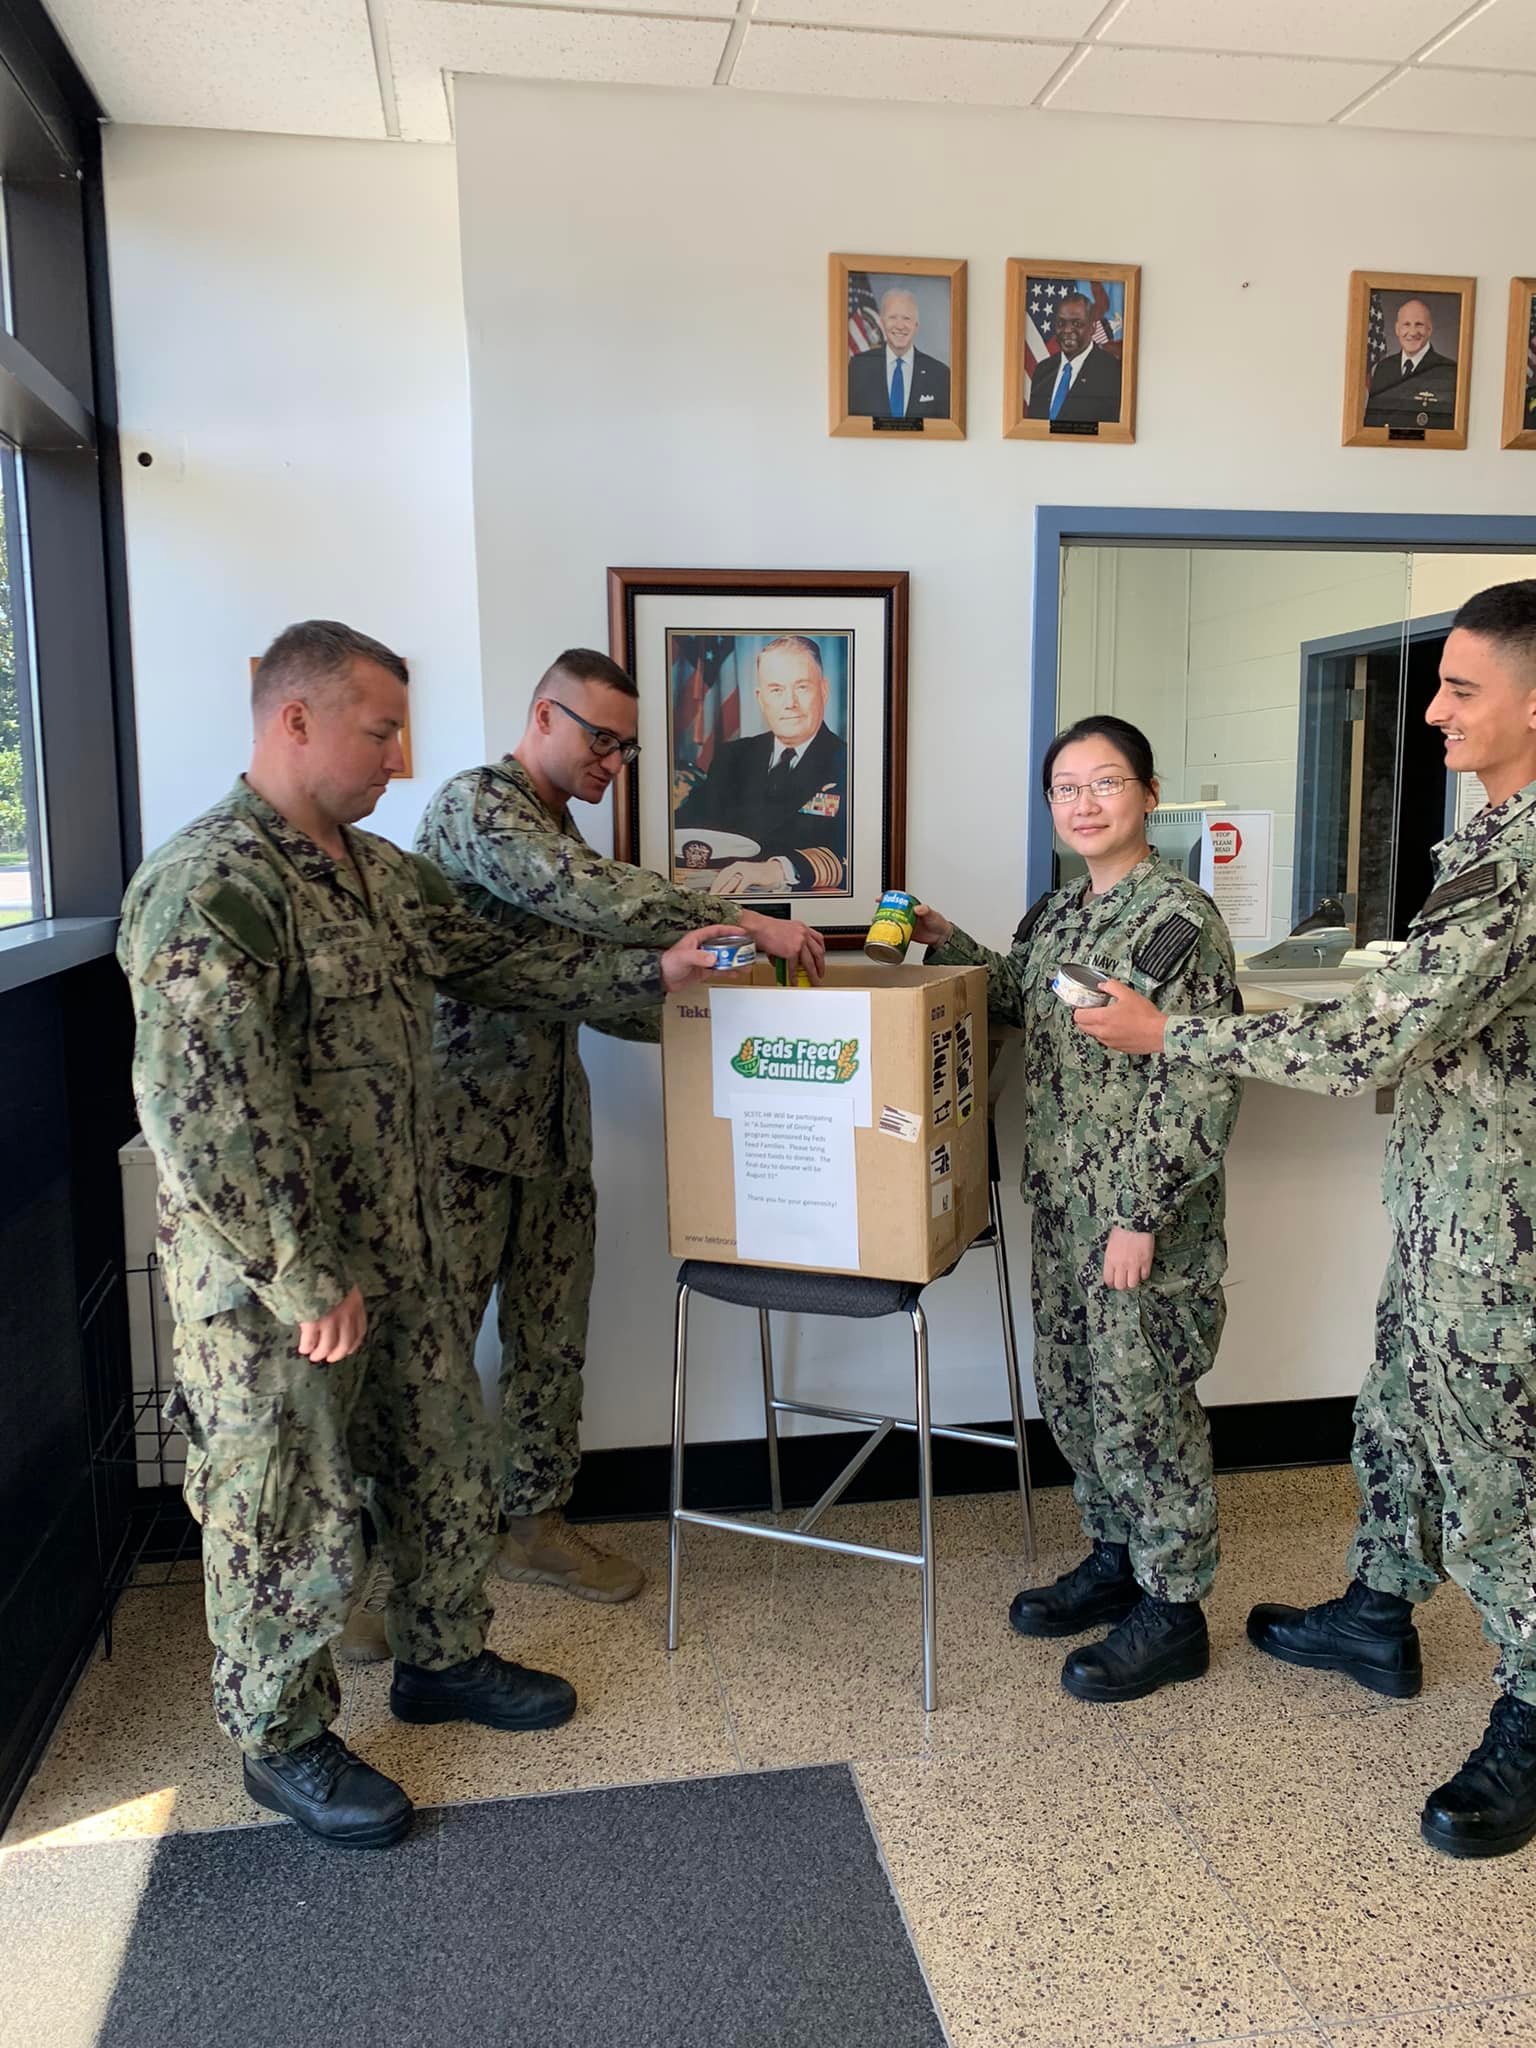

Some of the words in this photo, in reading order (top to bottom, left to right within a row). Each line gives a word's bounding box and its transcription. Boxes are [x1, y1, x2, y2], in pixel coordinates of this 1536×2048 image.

[1092, 953, 1120, 972] NAVY
[753, 1039, 793, 1059] Feds
[797, 1040, 842, 1060] Feed
[759, 1059, 836, 1080] Families
[795, 1113, 832, 1123] participating
[810, 1145, 825, 1153] bring
[819, 1155, 831, 1163] The
[759, 1162, 770, 1170] day
[746, 1171, 766, 1179] August
[747, 1193, 764, 1201] Thank
[803, 1199, 838, 1208] generosity!
